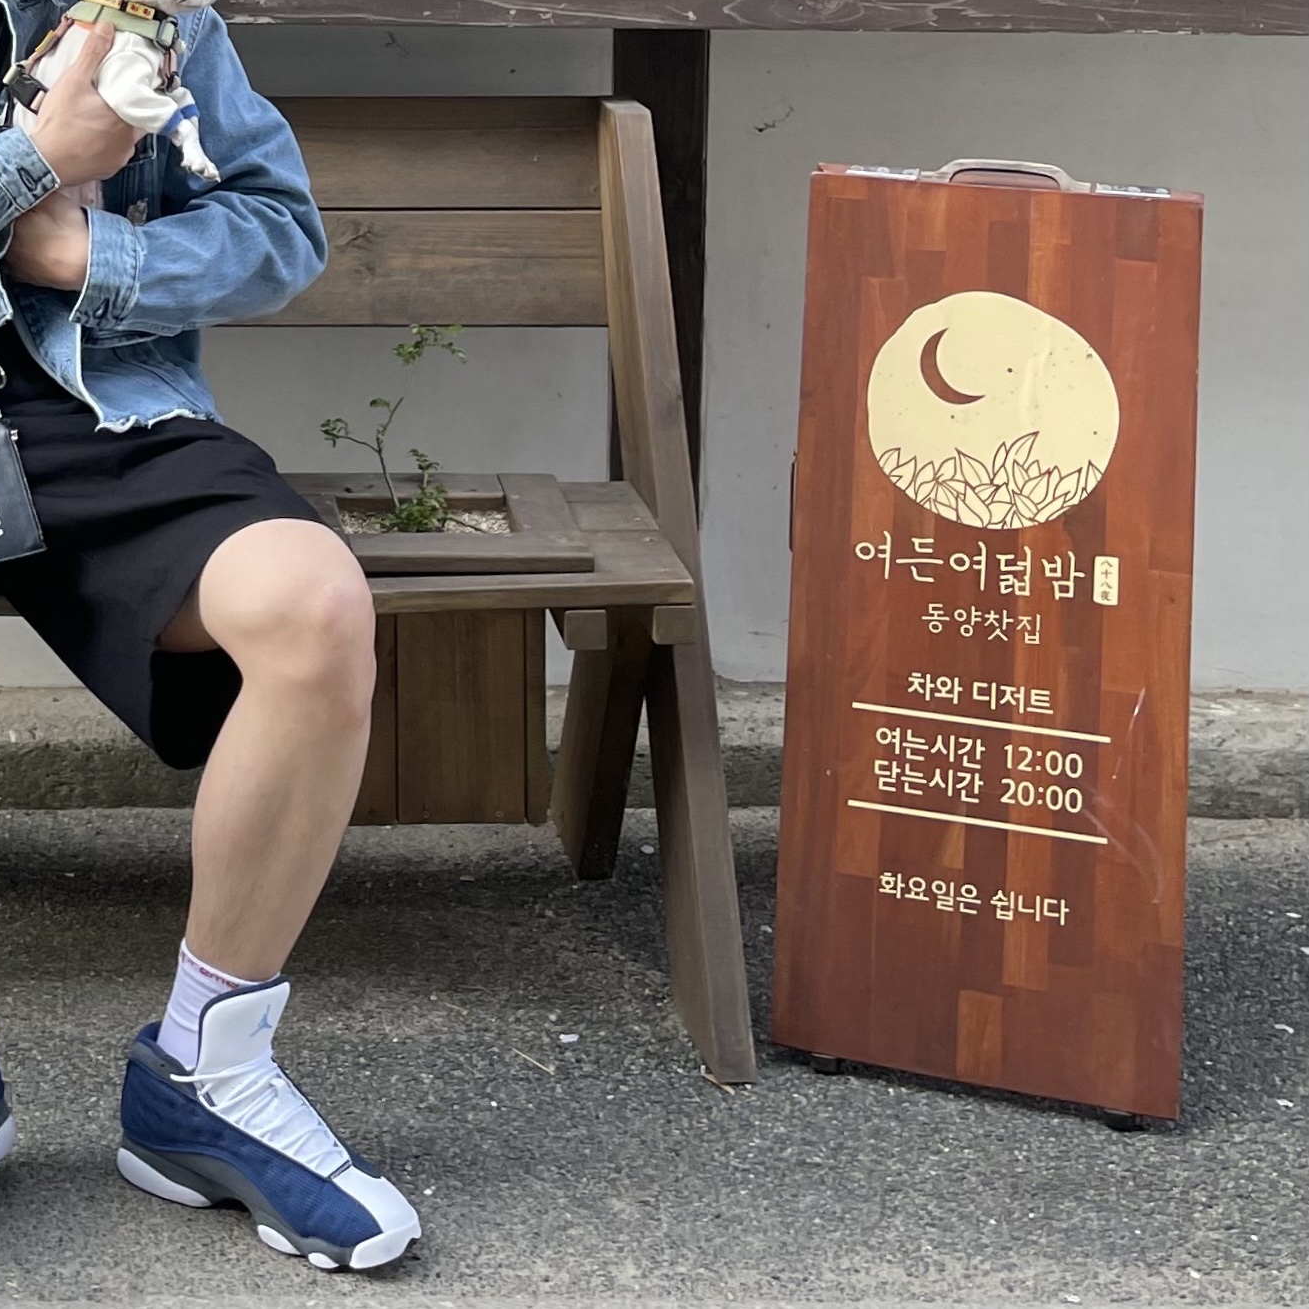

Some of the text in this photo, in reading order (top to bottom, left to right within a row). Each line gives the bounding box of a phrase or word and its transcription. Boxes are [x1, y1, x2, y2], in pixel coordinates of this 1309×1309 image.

[921, 603, 1042, 645] 동양찻집
[907, 673, 1054, 715] 차와 디저트
[875, 727, 1083, 779] 여는시간 12:00
[874, 759, 1083, 813] 닫는시간 20:00
[878, 872, 1070, 926] 화요일은 쉽니다
